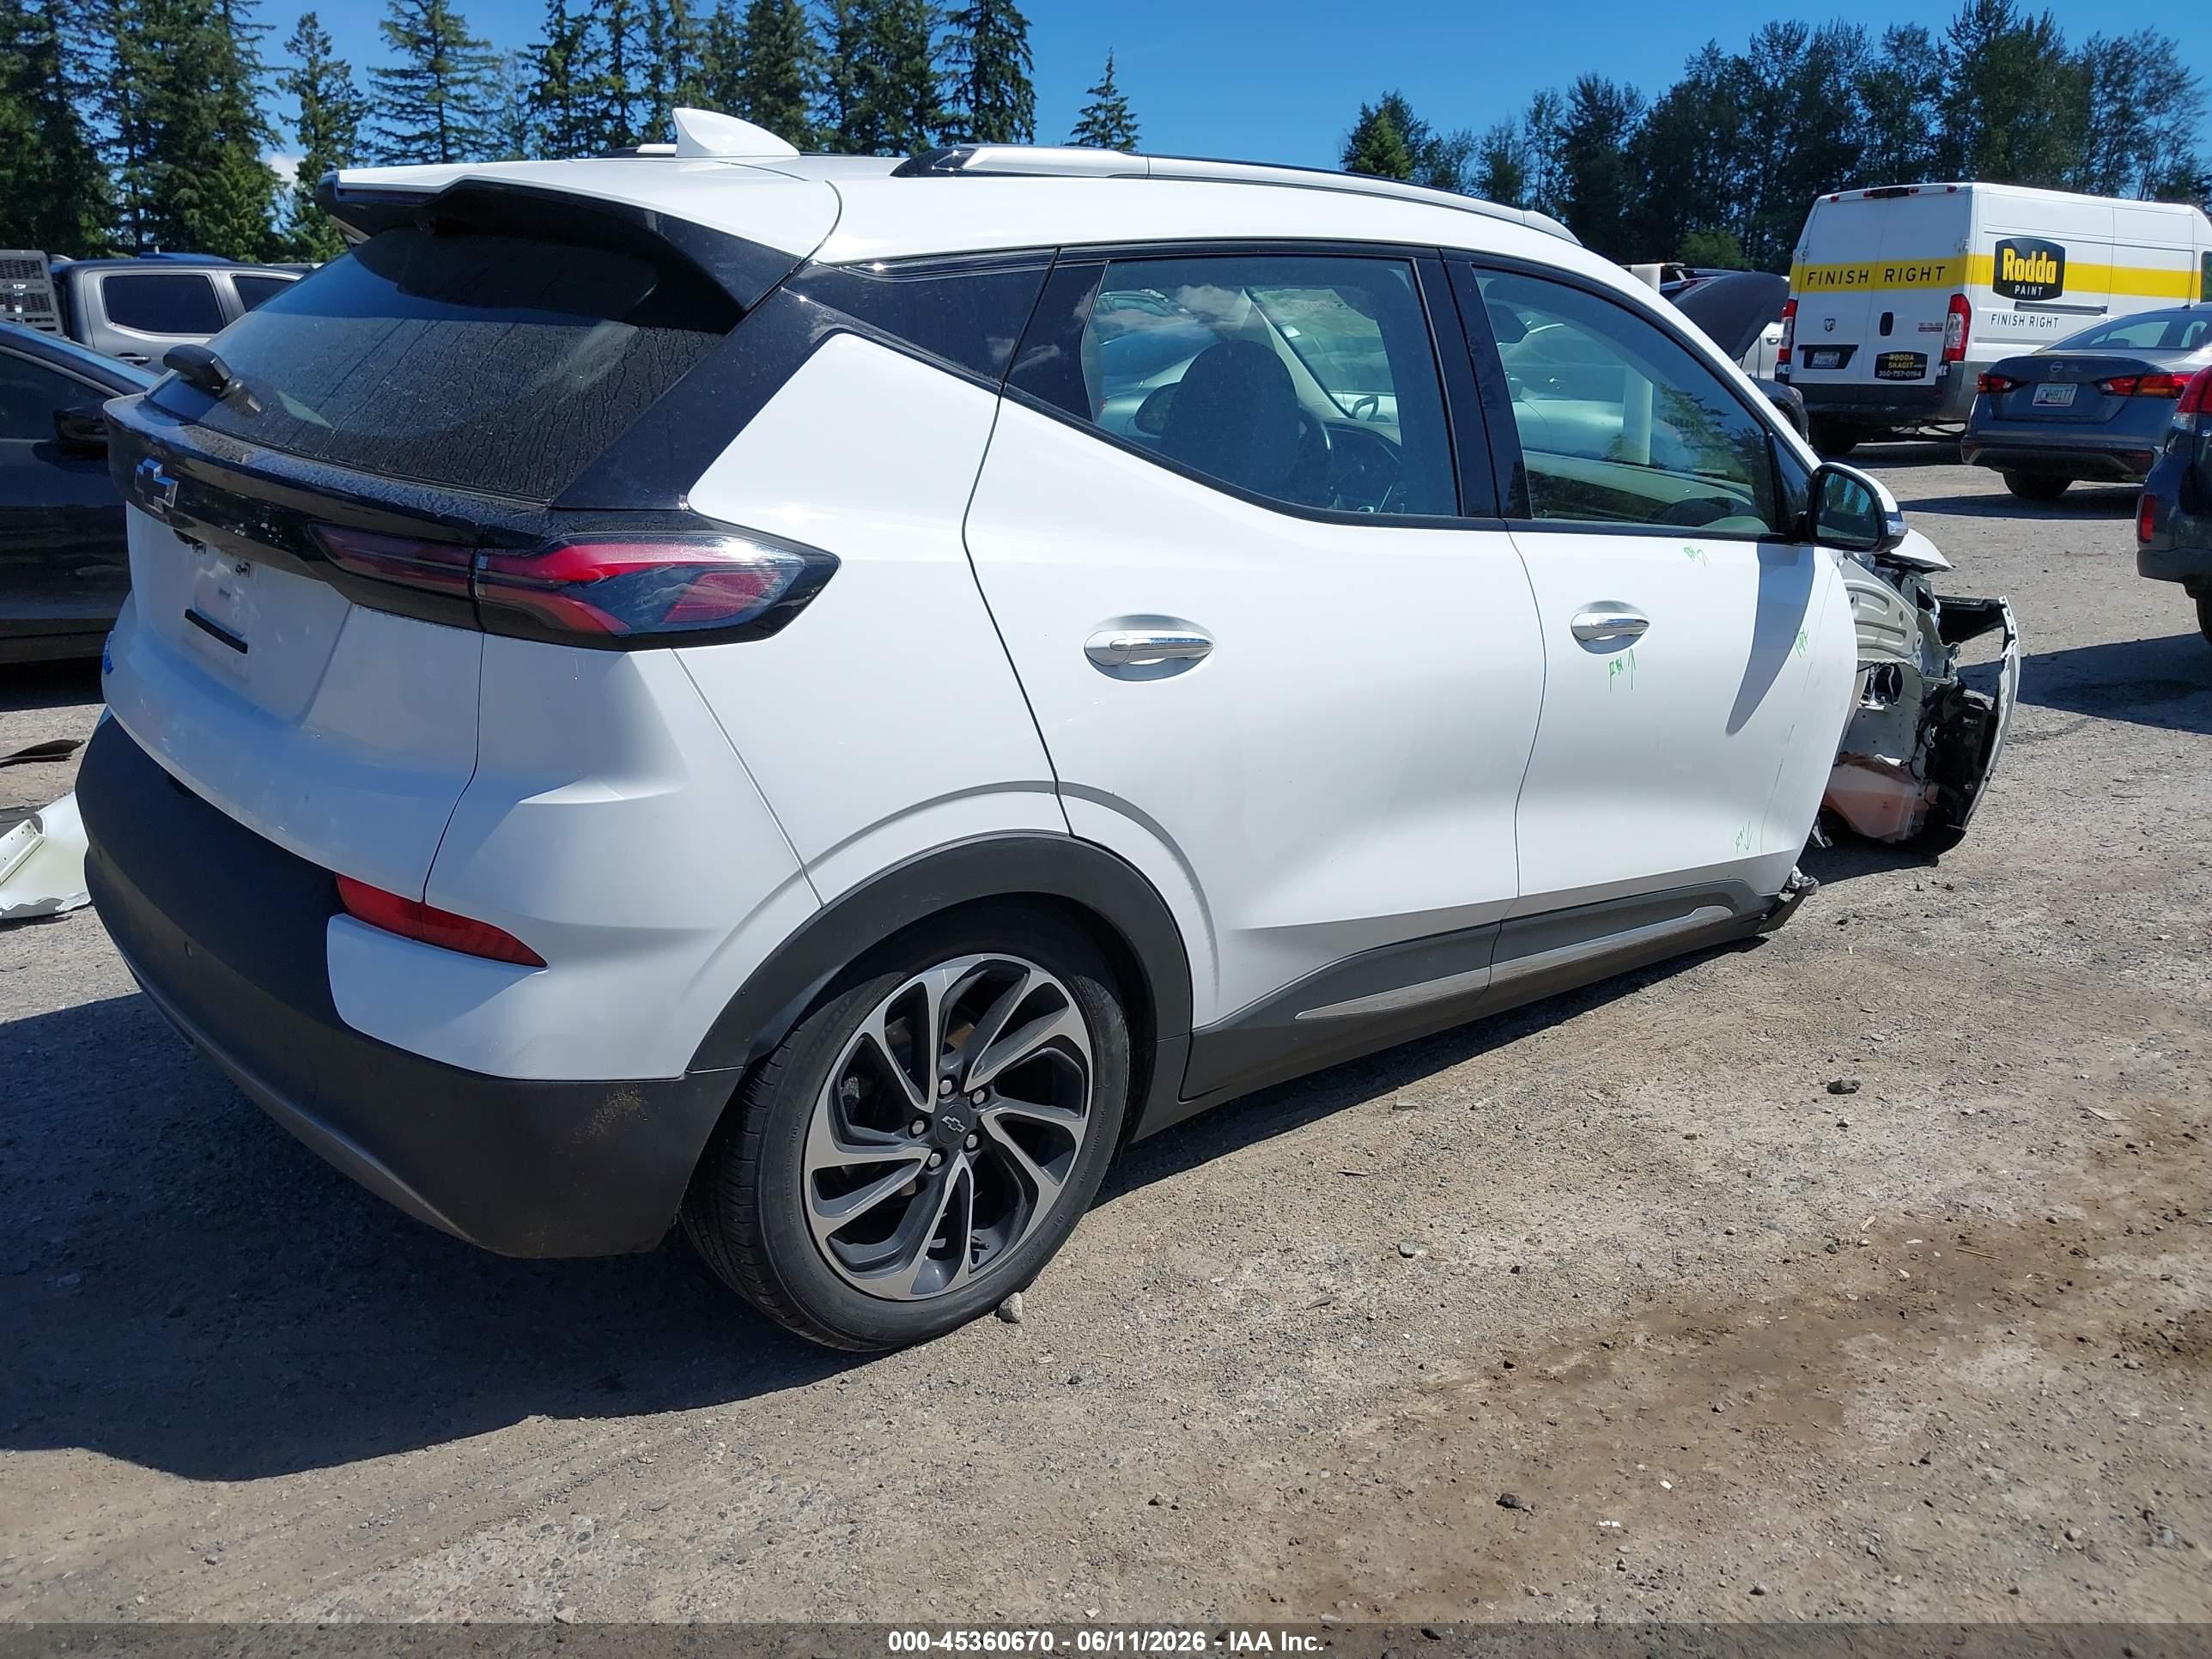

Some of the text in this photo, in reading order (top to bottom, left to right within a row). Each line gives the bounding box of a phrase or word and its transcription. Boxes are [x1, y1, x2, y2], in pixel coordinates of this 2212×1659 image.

[2002, 247, 2057, 284] Rodda
[1807, 265, 1946, 286] FINISH RIGHT
[2014, 284, 2043, 296] PAINT
[1990, 313, 2059, 329] FINISH RIGHT
